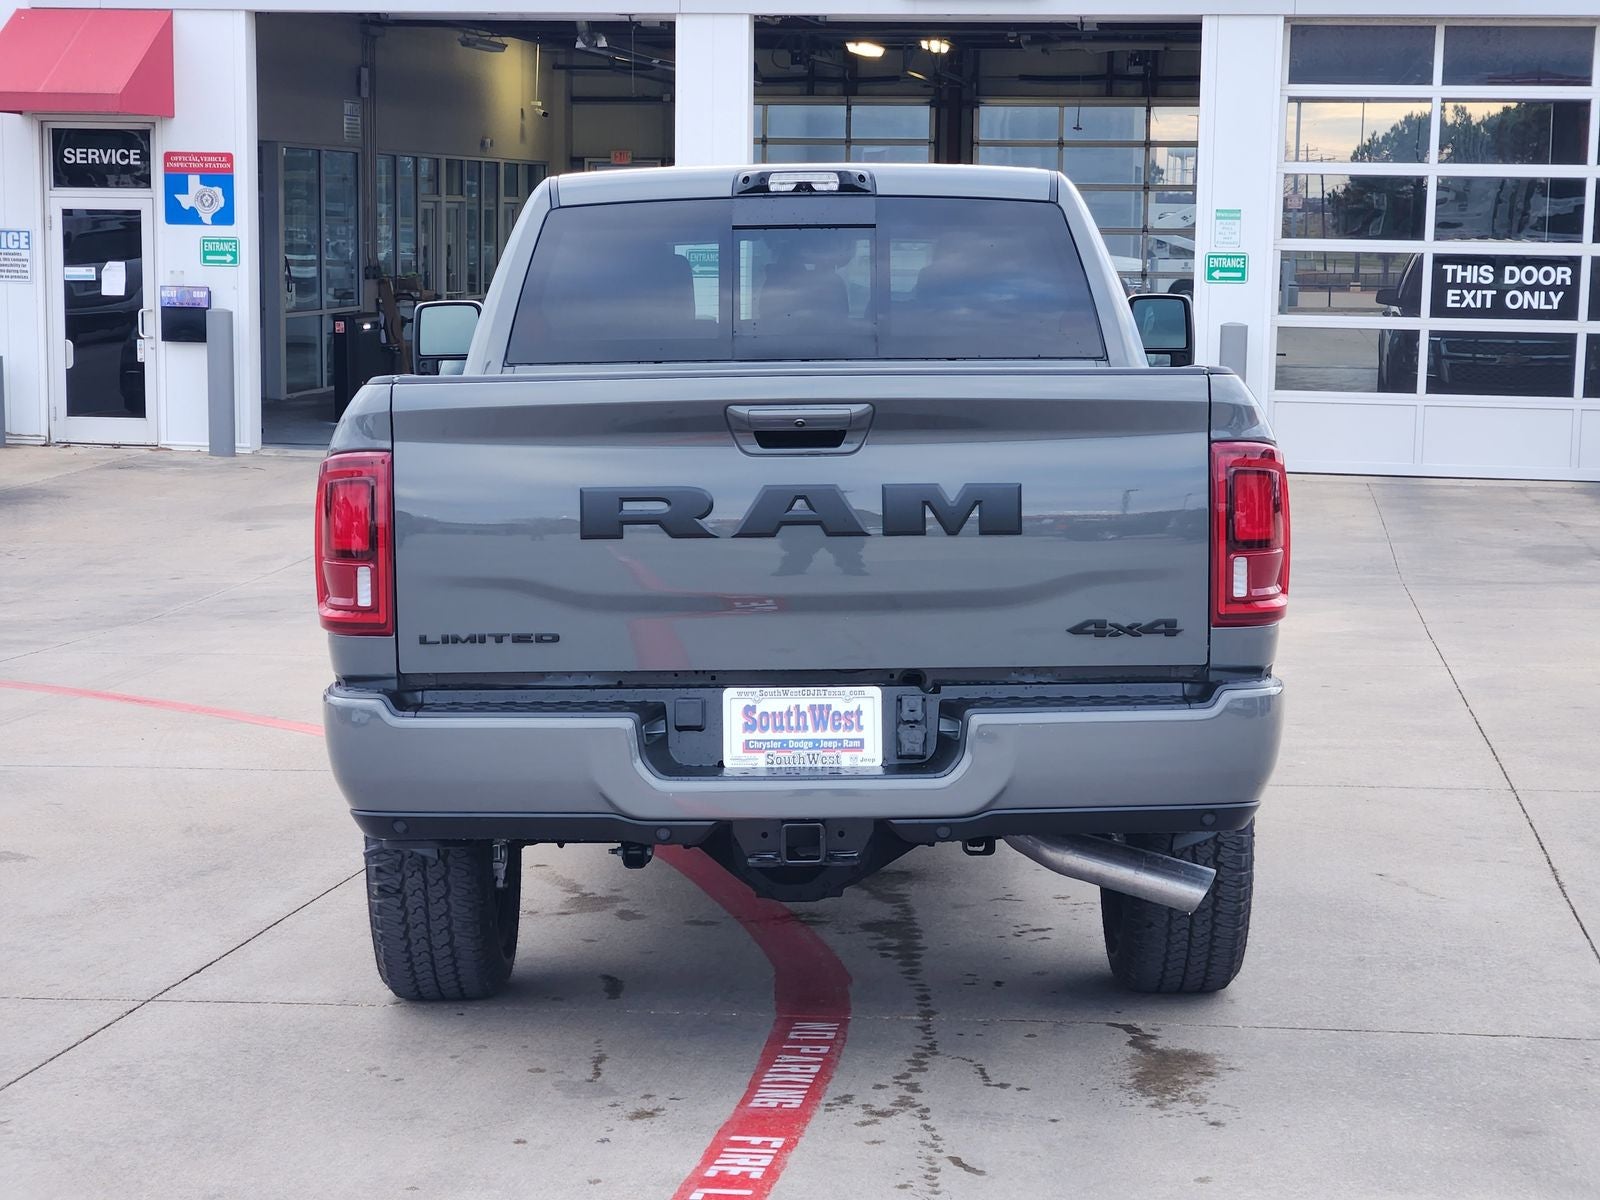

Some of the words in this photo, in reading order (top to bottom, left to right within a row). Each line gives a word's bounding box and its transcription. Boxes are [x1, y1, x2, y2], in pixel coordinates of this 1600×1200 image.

[63, 148, 141, 165] SERVICE
[204, 241, 236, 252] ENTRANCE
[1209, 257, 1245, 268] ENTRANCE
[1442, 265, 1494, 284] THIS
[1504, 265, 1572, 285] DOOR
[1446, 289, 1497, 309] EXIT
[1505, 290, 1564, 310] ONLY
[580, 483, 1022, 540] RAM
[1065, 618, 1184, 638] 4x4
[418, 633, 561, 645] LIMITED
[741, 703, 865, 734] SouthWest
[748, 740, 782, 750] Chrysler
[788, 740, 813, 749] Dodge
[819, 739, 838, 749] Jeep
[843, 739, 861, 748] Ram
[766, 753, 841, 766] SouthWest
[788, 1022, 840, 1040] NO
[748, 1045, 831, 1109] PARKING
[703, 1135, 786, 1179] FIRE
